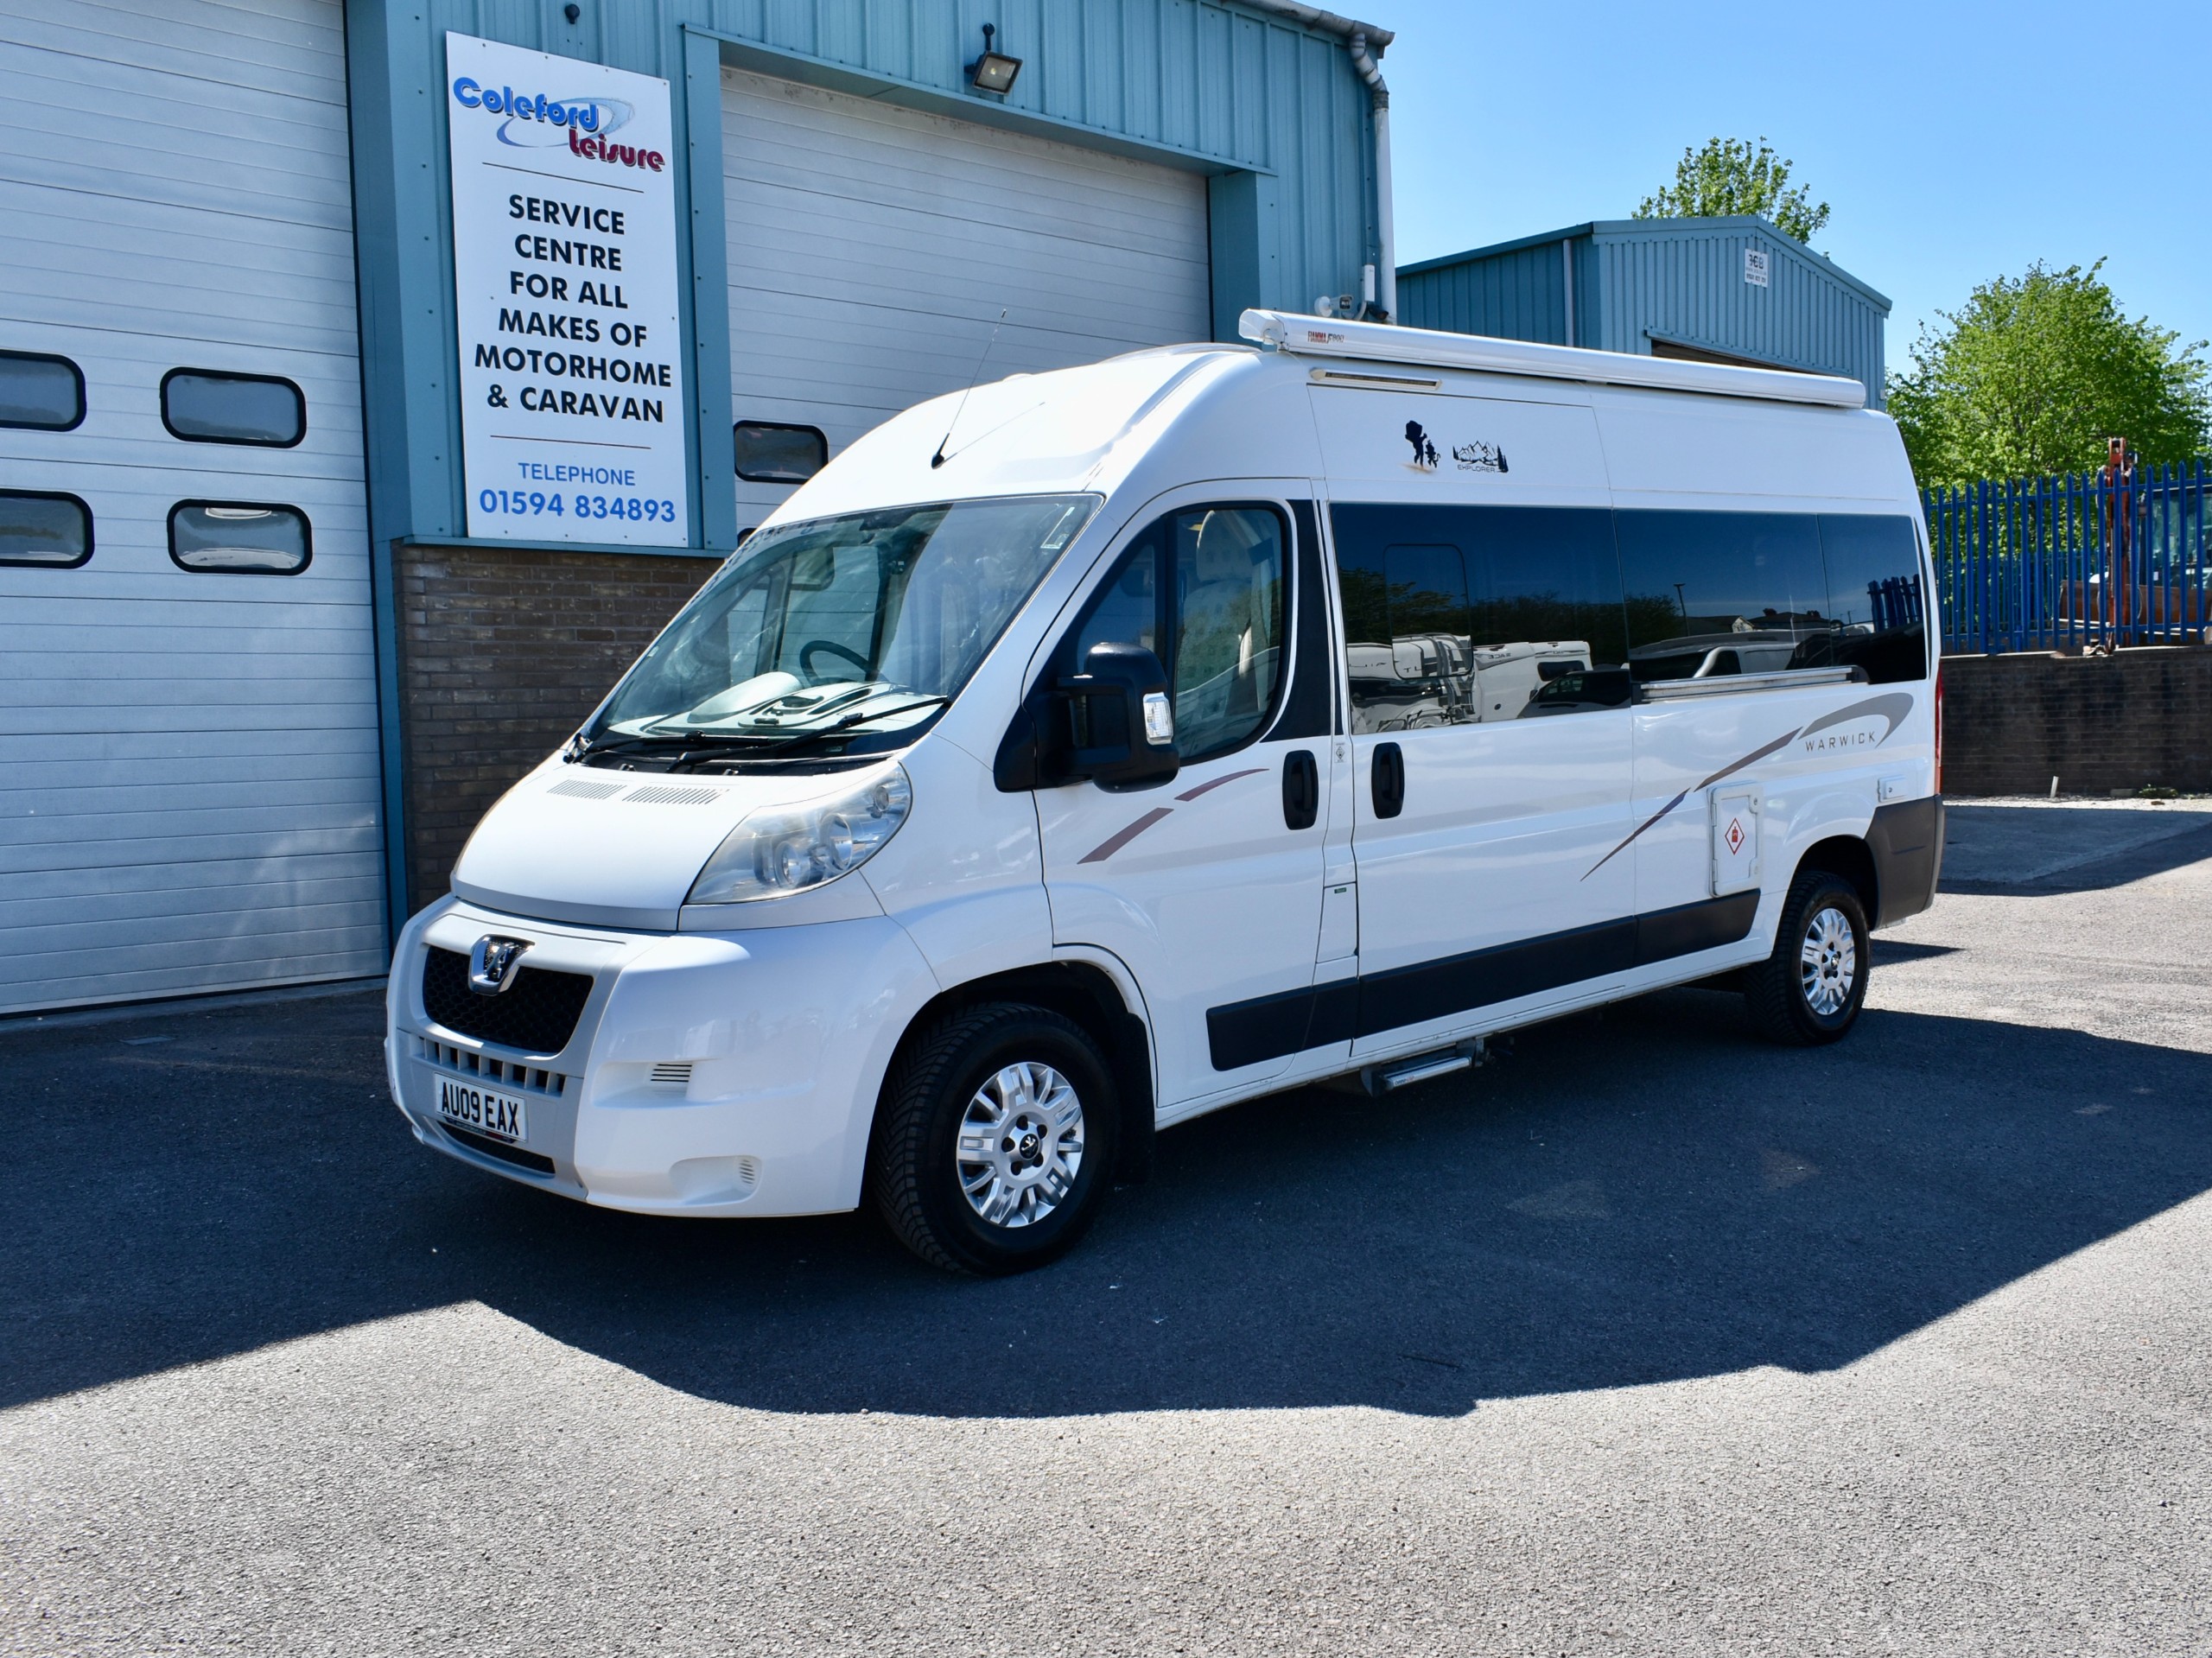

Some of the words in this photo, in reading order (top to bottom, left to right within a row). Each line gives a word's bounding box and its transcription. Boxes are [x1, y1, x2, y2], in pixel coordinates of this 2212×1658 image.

[453, 77, 599, 130] Coleford
[569, 129, 665, 172] Leisure
[509, 194, 625, 234] SERVICE
[514, 234, 621, 271] CENTRE
[510, 270, 569, 302] FOR
[578, 281, 628, 308] ALL
[499, 308, 600, 342] MAKES
[610, 322, 647, 347] OF
[474, 344, 671, 387] MOTORHOME
[487, 384, 509, 408] &
[519, 386, 663, 422] CARAVAN
[518, 462, 636, 486] TELEPHONE
[480, 489, 564, 517] 01594
[575, 495, 676, 523] 834893
[1805, 731, 1875, 752] WARWICK
[442, 1082, 480, 1123] AU09
[485, 1095, 519, 1135] EAX
